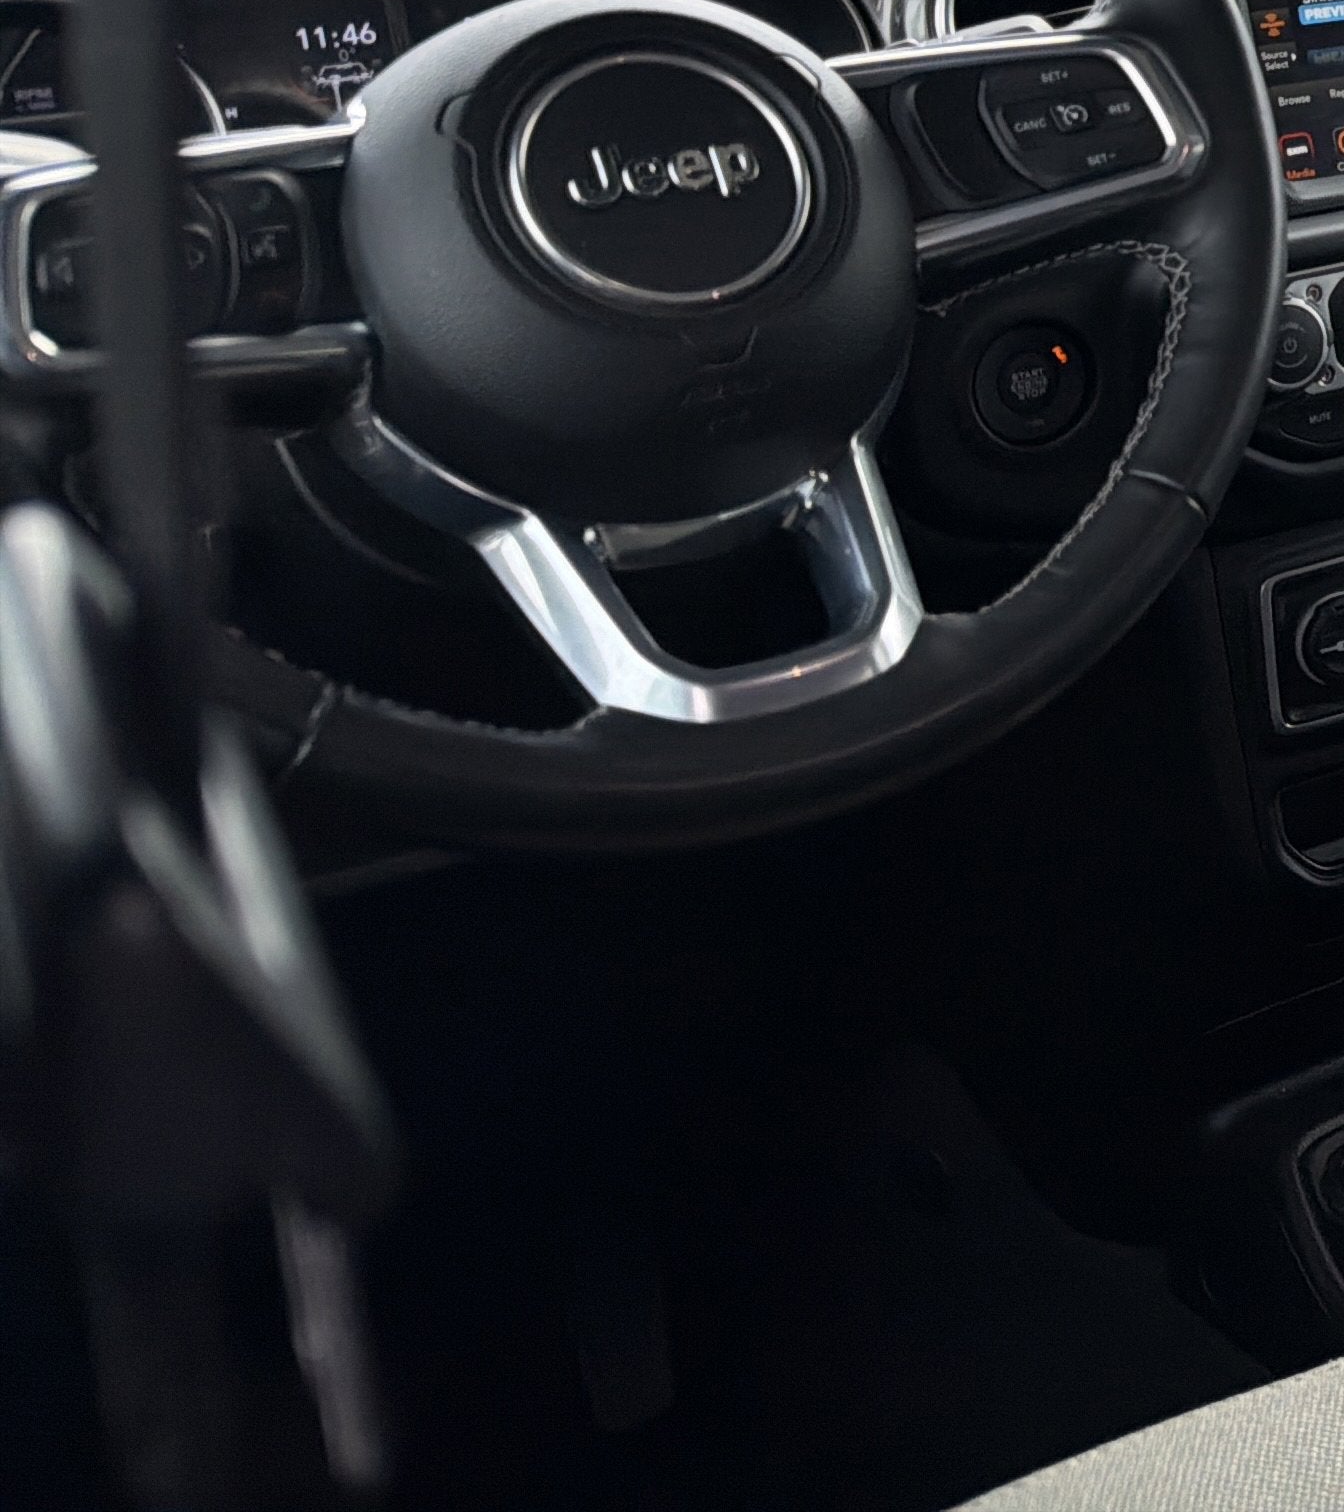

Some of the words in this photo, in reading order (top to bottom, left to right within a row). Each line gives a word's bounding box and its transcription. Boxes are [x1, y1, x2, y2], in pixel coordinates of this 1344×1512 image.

[295, 21, 377, 51] 11:46
[1261, 50, 1288, 61] Source
[1265, 61, 1289, 72] Select
[1278, 94, 1311, 107] Browse
[568, 143, 760, 207] Jeep
[1309, 411, 1332, 424] MUTE
